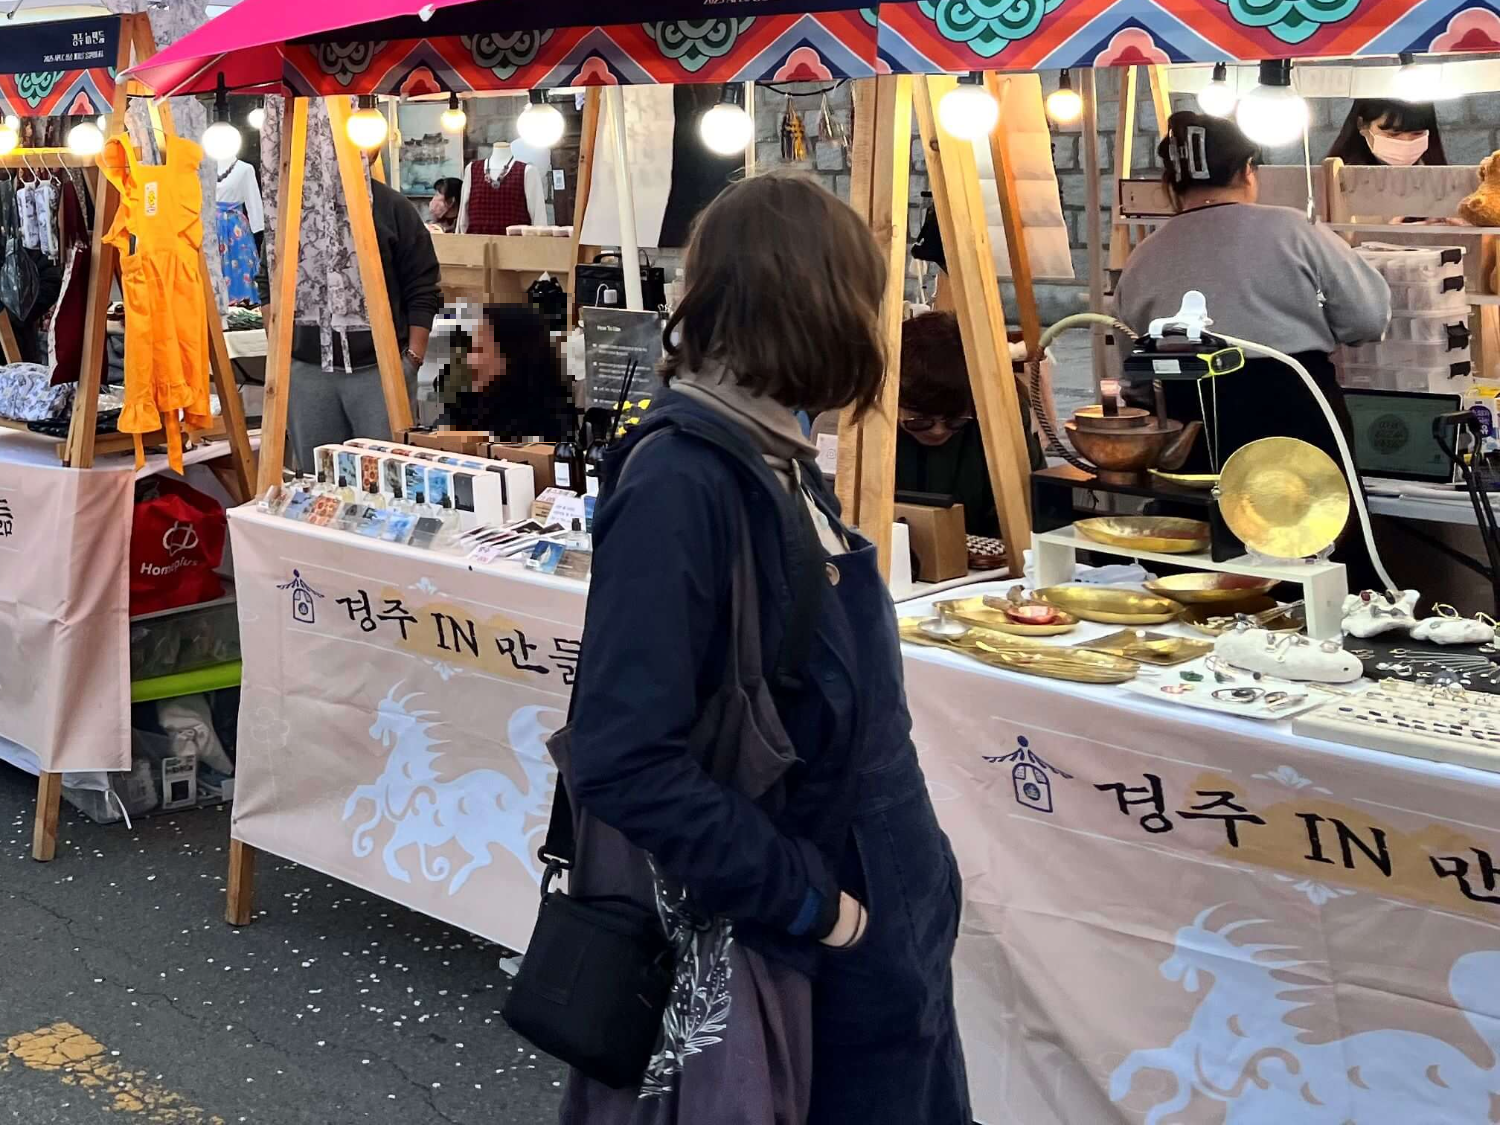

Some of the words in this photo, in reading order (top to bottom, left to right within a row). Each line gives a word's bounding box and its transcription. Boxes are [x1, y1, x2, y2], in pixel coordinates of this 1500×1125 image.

[335, 589, 418, 641] 경주
[430, 612, 479, 658] IN
[1093, 773, 1267, 848] 경주
[1294, 811, 1392, 878] IN
